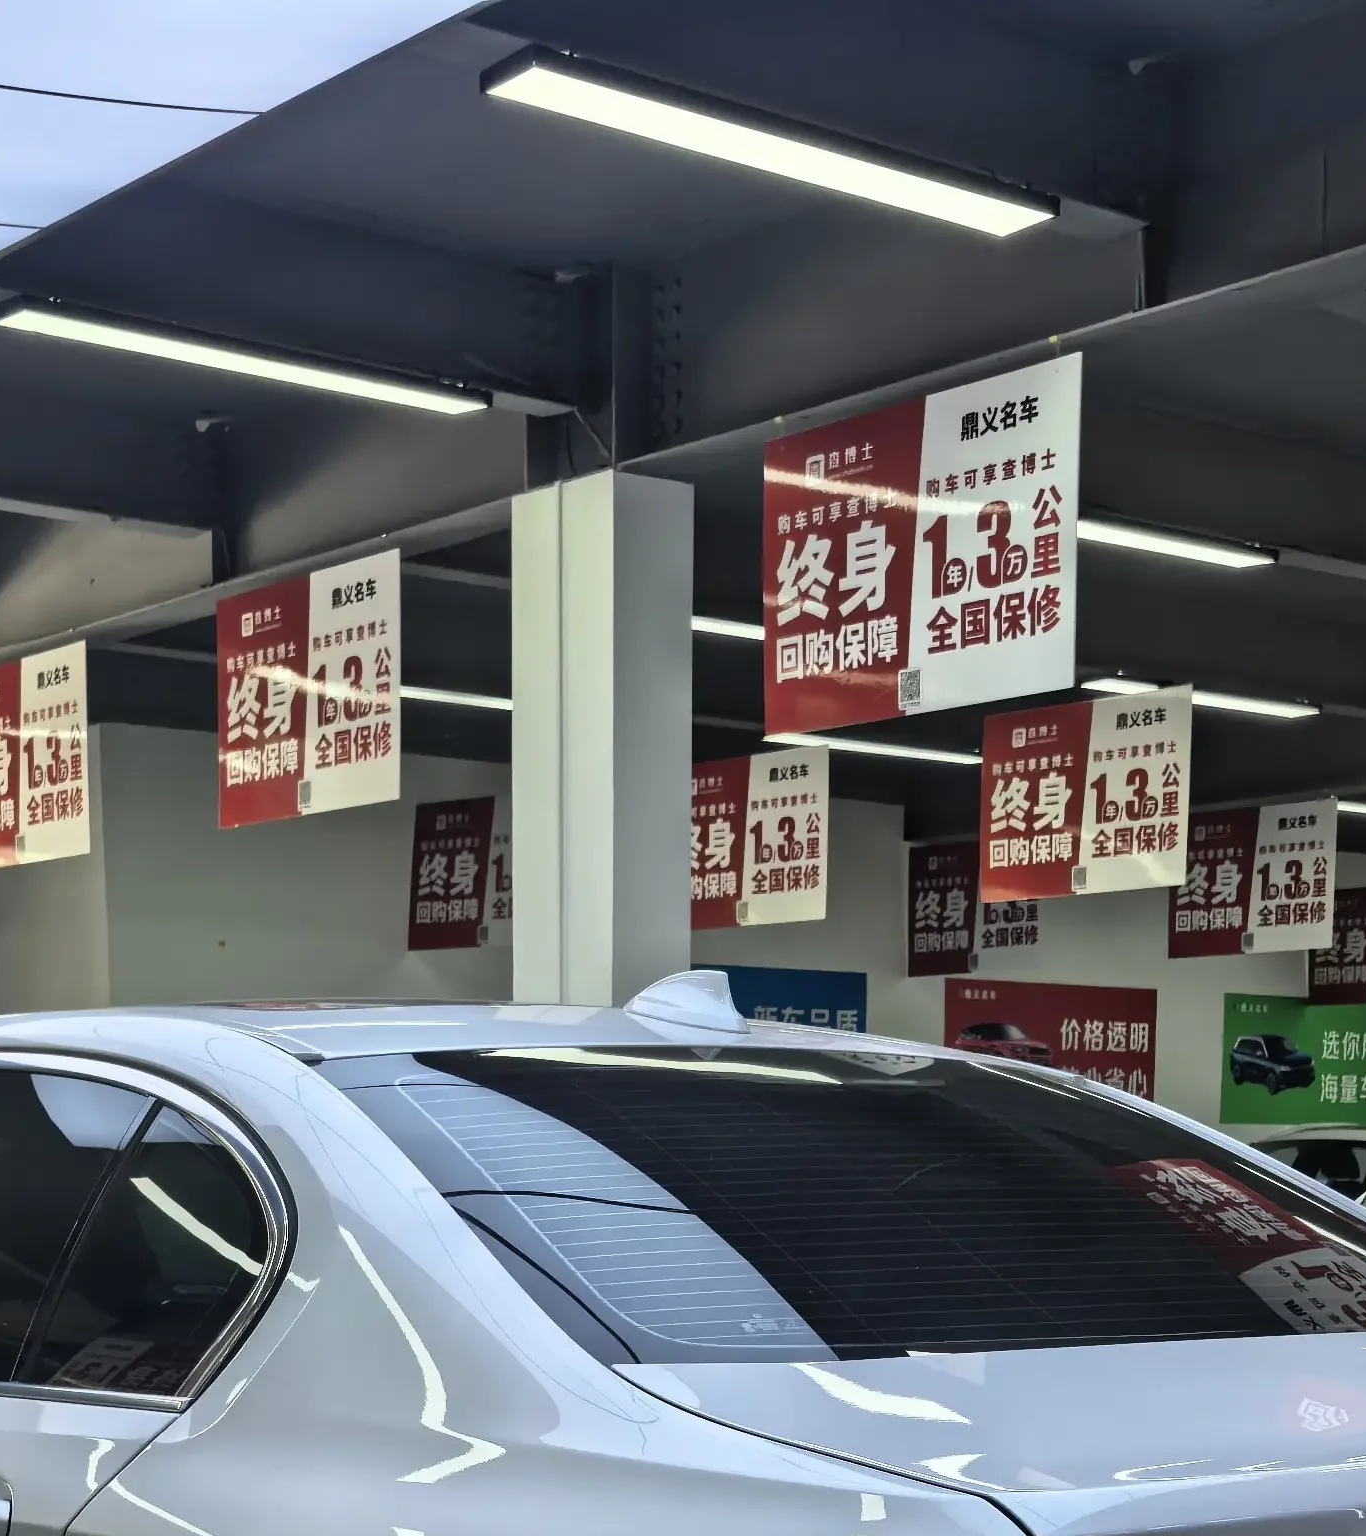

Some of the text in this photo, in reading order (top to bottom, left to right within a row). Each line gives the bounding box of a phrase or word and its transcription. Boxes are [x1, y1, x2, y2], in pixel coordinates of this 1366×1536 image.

[960, 395, 1039, 442] 鼎义名车
[828, 441, 874, 472] 查博士
[926, 448, 1057, 499] 购车可享查博士
[777, 491, 896, 536] 购车可享查博士
[776, 519, 896, 628] 终身
[331, 579, 377, 609] 鼎义名车
[313, 618, 387, 652] 购车可享查博士
[927, 584, 1062, 656] 全国保修
[776, 614, 897, 684] 回购保障
[227, 666, 296, 744] 终身
[1116, 708, 1166, 730] 鼎义名车
[227, 738, 298, 788] 回购保障
[315, 720, 392, 770] 全国保修
[27, 787, 84, 826] 全国保修
[990, 771, 1073, 834] 终身
[990, 832, 1072, 869] 回购保障
[1092, 822, 1179, 859] 全国保修
[418, 850, 479, 897] 终身
[751, 864, 820, 895] 全国保修
[1176, 860, 1242, 905] 终身
[416, 898, 479, 924] 回购保障
[915, 889, 968, 929] 终身
[1175, 905, 1243, 933] 回购保障
[1257, 902, 1326, 928] 全国保修
[1060, 1017, 1149, 1054] 价格透明
